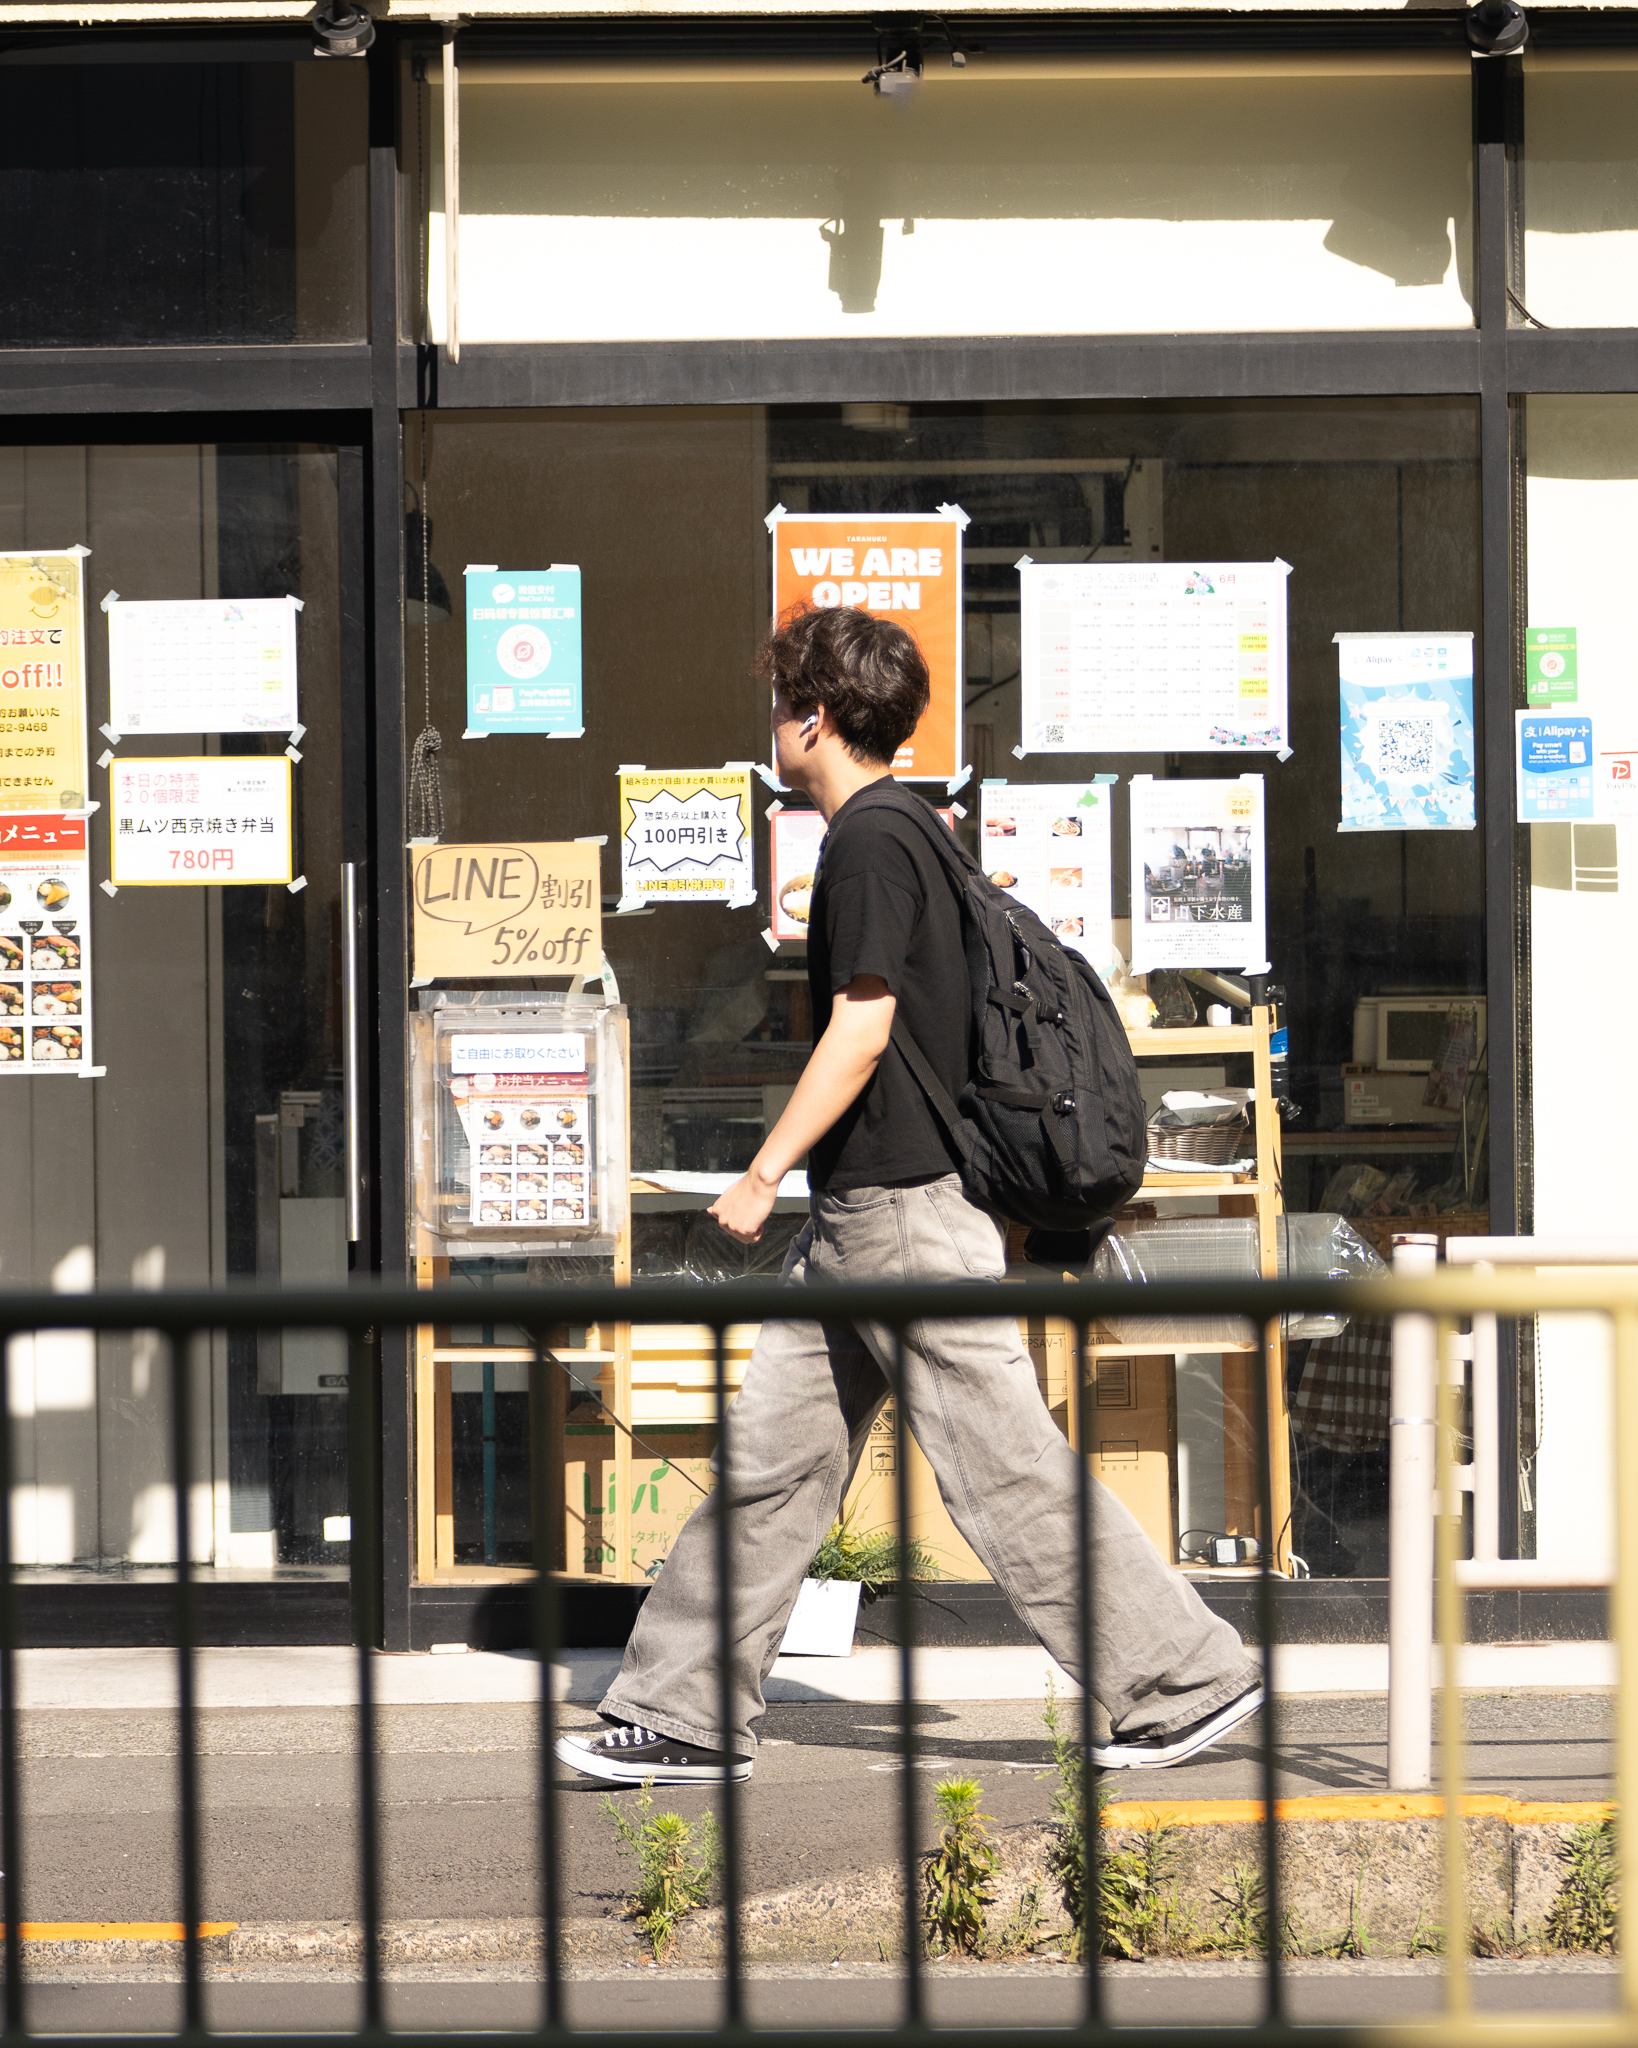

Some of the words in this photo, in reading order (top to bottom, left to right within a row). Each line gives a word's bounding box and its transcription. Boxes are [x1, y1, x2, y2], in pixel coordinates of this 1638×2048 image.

[790, 547, 855, 576] WE
[860, 547, 943, 576] ARE
[812, 581, 921, 610] OPEN
[2, 664, 62, 688] off!!
[0, 777, 54, 787] できません
[122, 773, 200, 788] 本日の特売
[0, 825, 80, 844] メニュー
[119, 817, 275, 834] 黒ムツ西京焼き弁当
[644, 827, 728, 844] 100円引き
[169, 849, 234, 870] 780円
[424, 858, 524, 904] LINE
[540, 874, 592, 909] 割引
[1174, 904, 1243, 921] 山下水産
[492, 926, 593, 965] 5%off
